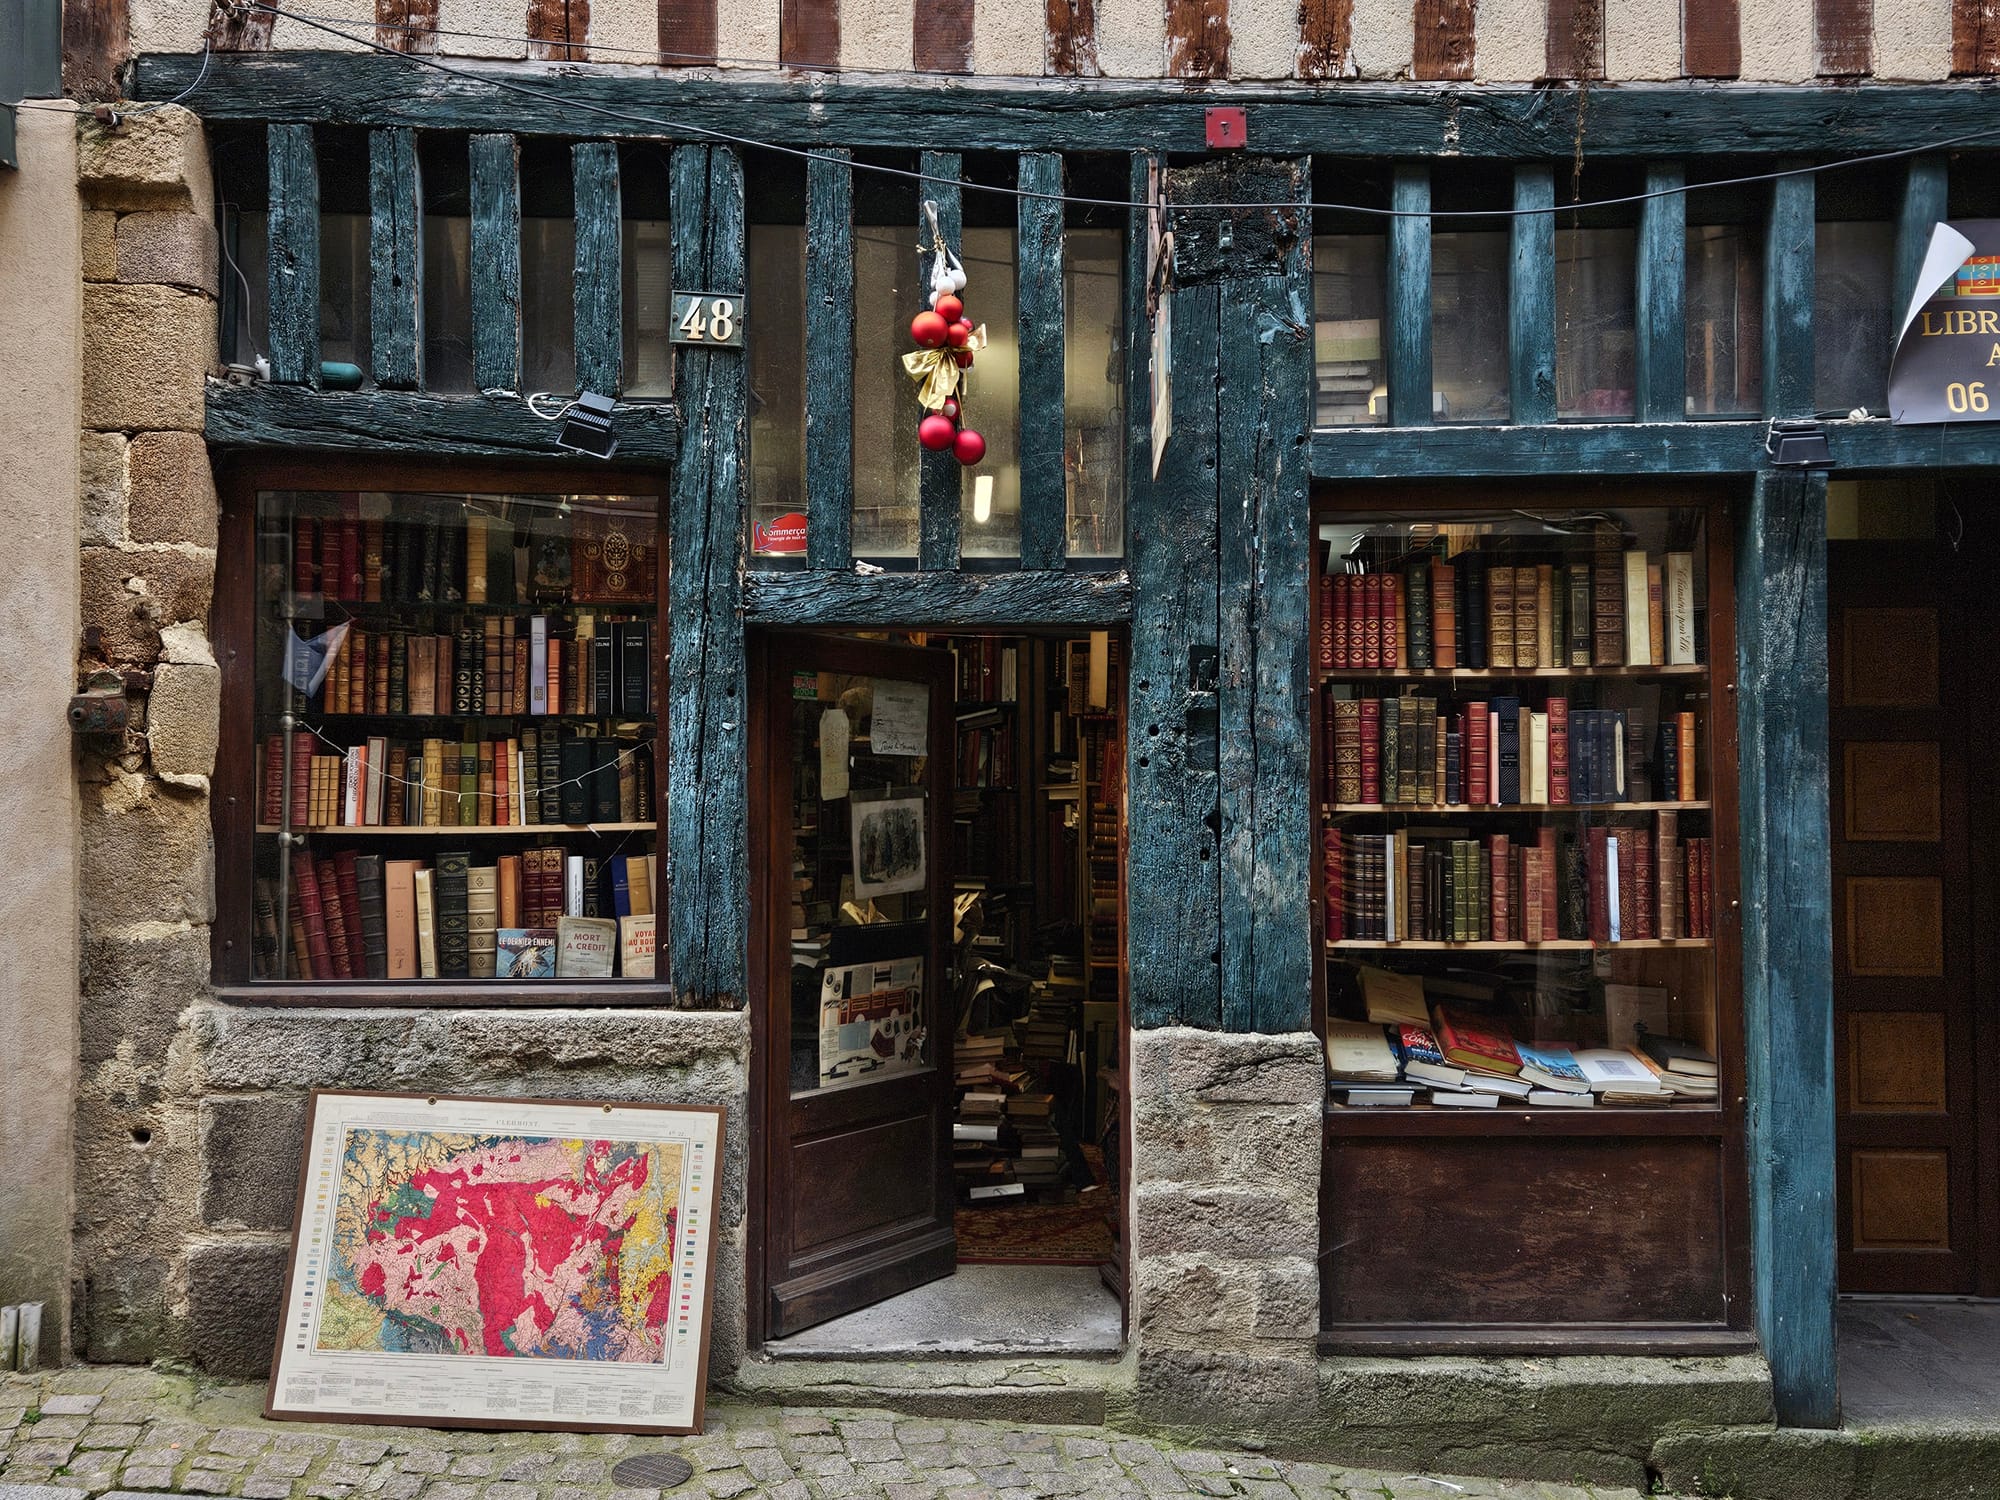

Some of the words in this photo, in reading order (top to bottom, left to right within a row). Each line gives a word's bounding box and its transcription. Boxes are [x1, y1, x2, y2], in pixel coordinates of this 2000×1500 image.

[680, 296, 734, 342] 48
[1921, 310, 2000, 337] LIBR
[1946, 381, 1990, 413] 06
[498, 937, 507, 945] LE
[507, 937, 532, 947] DERNIER
[533, 937, 555, 946] ENNEMI
[573, 933, 601, 942] MORT
